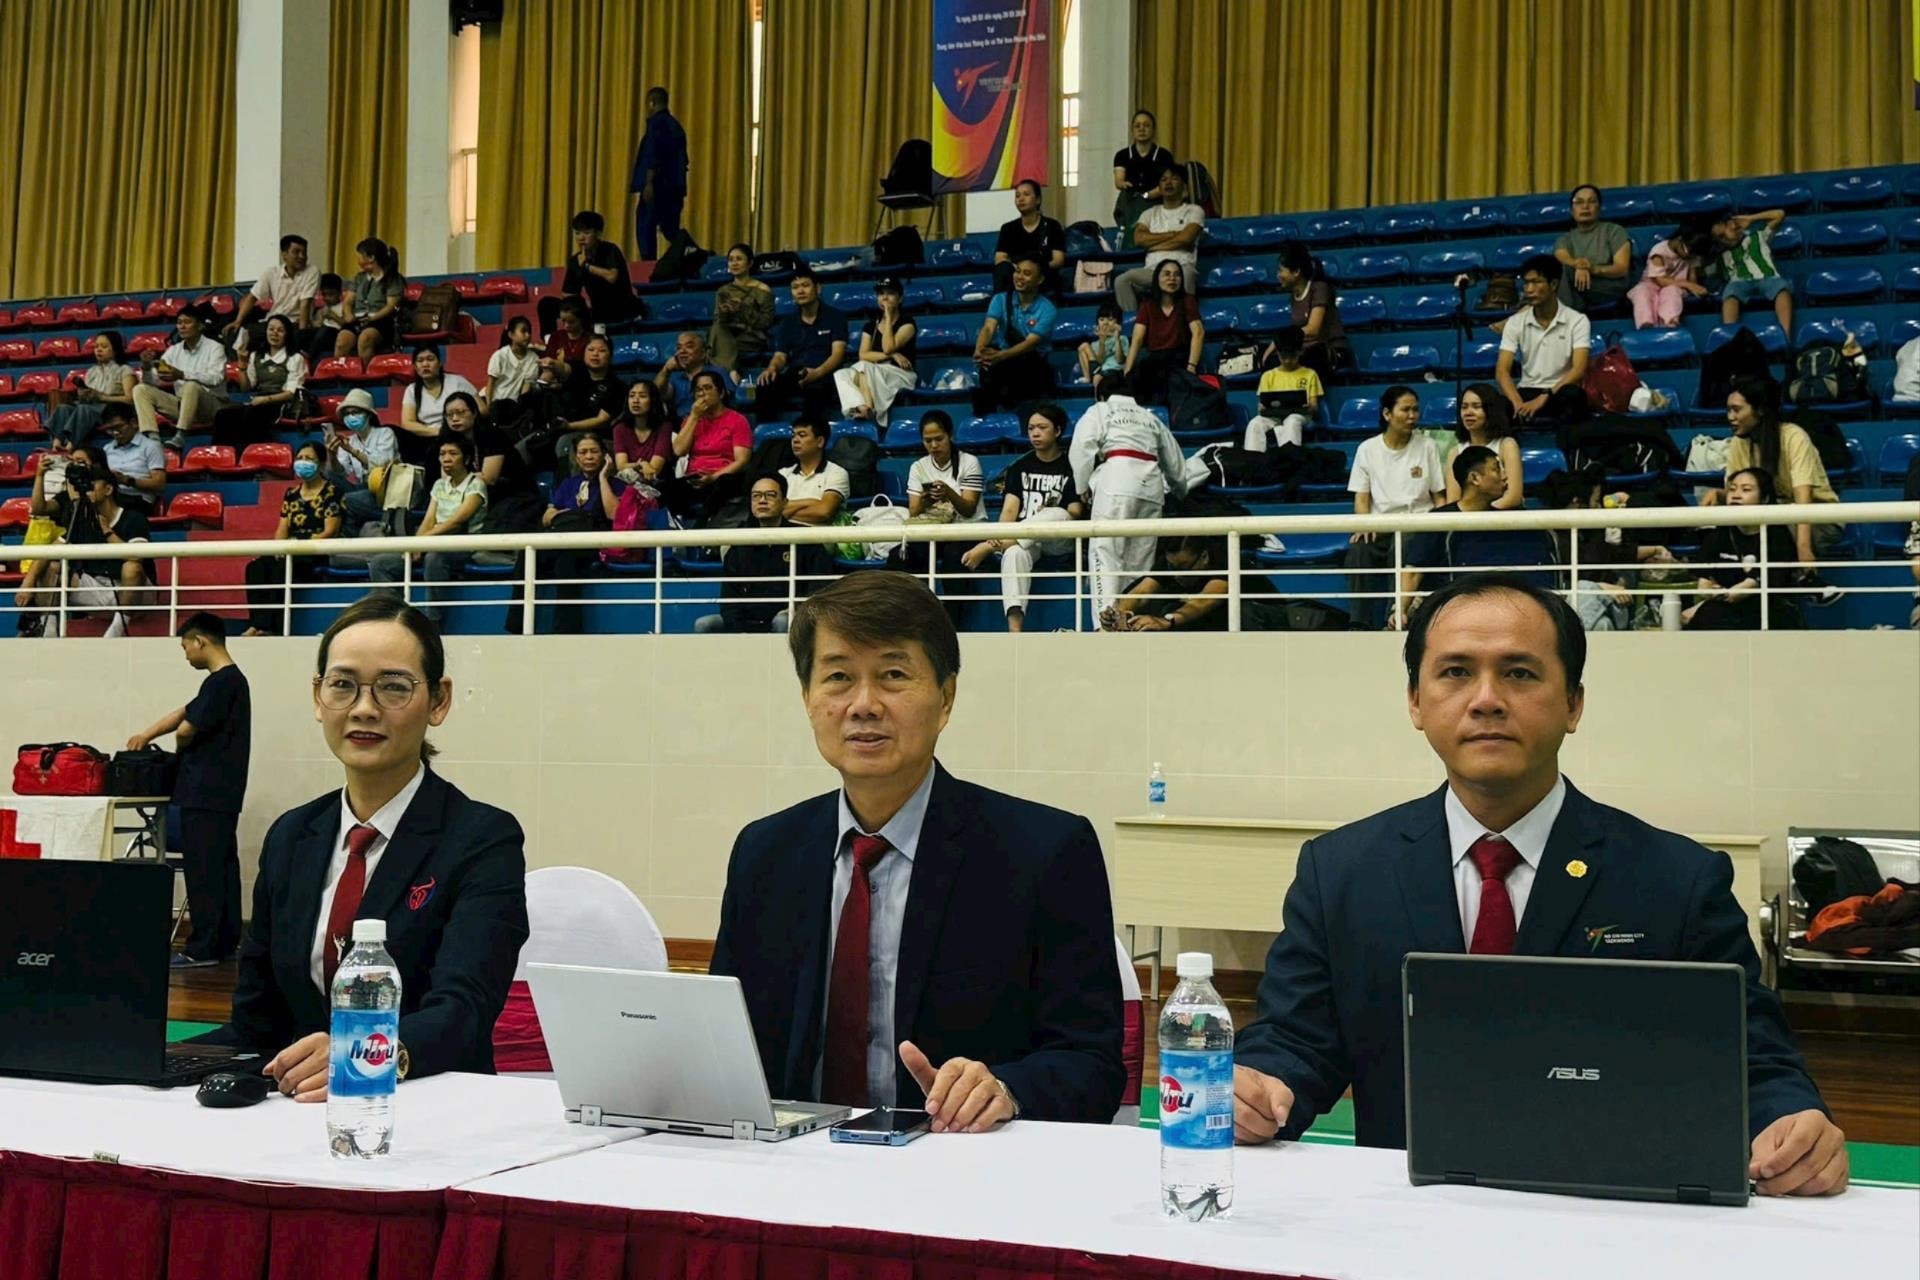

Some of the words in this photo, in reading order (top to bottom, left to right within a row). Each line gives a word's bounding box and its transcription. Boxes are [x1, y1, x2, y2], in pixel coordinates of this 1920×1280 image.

[17, 952, 55, 966] acer
[620, 1011, 656, 1020] Panasonic
[1547, 1067, 1600, 1081] ASUS
